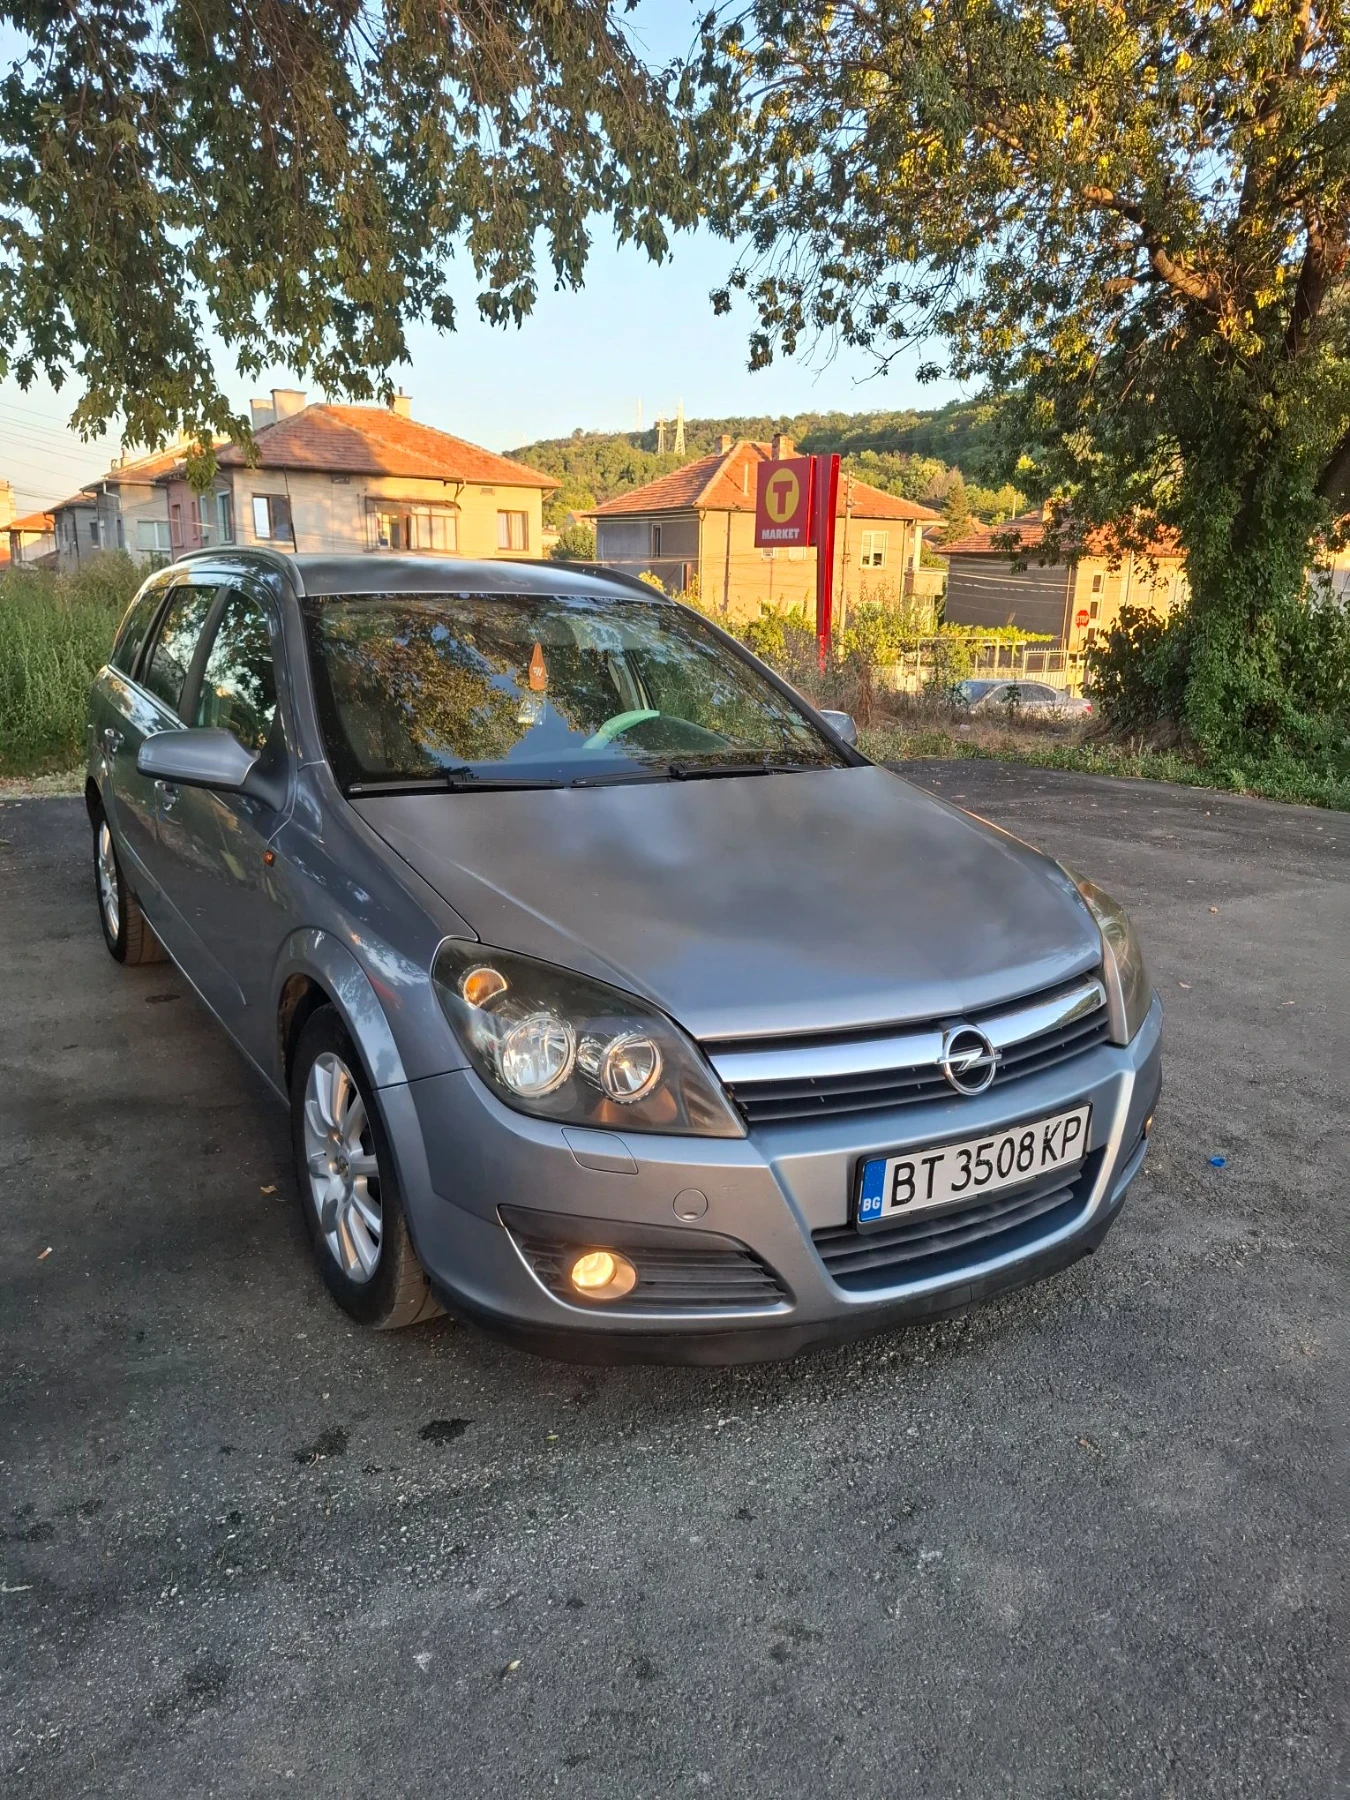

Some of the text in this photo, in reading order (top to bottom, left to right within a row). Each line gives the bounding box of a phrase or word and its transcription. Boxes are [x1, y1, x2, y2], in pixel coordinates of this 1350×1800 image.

[773, 481, 793, 514] T
[762, 528, 799, 539] MARKET
[1075, 615, 1089, 624] STOP
[891, 1116, 1082, 1207] BT 3508 KP
[862, 1196, 881, 1212] BG
